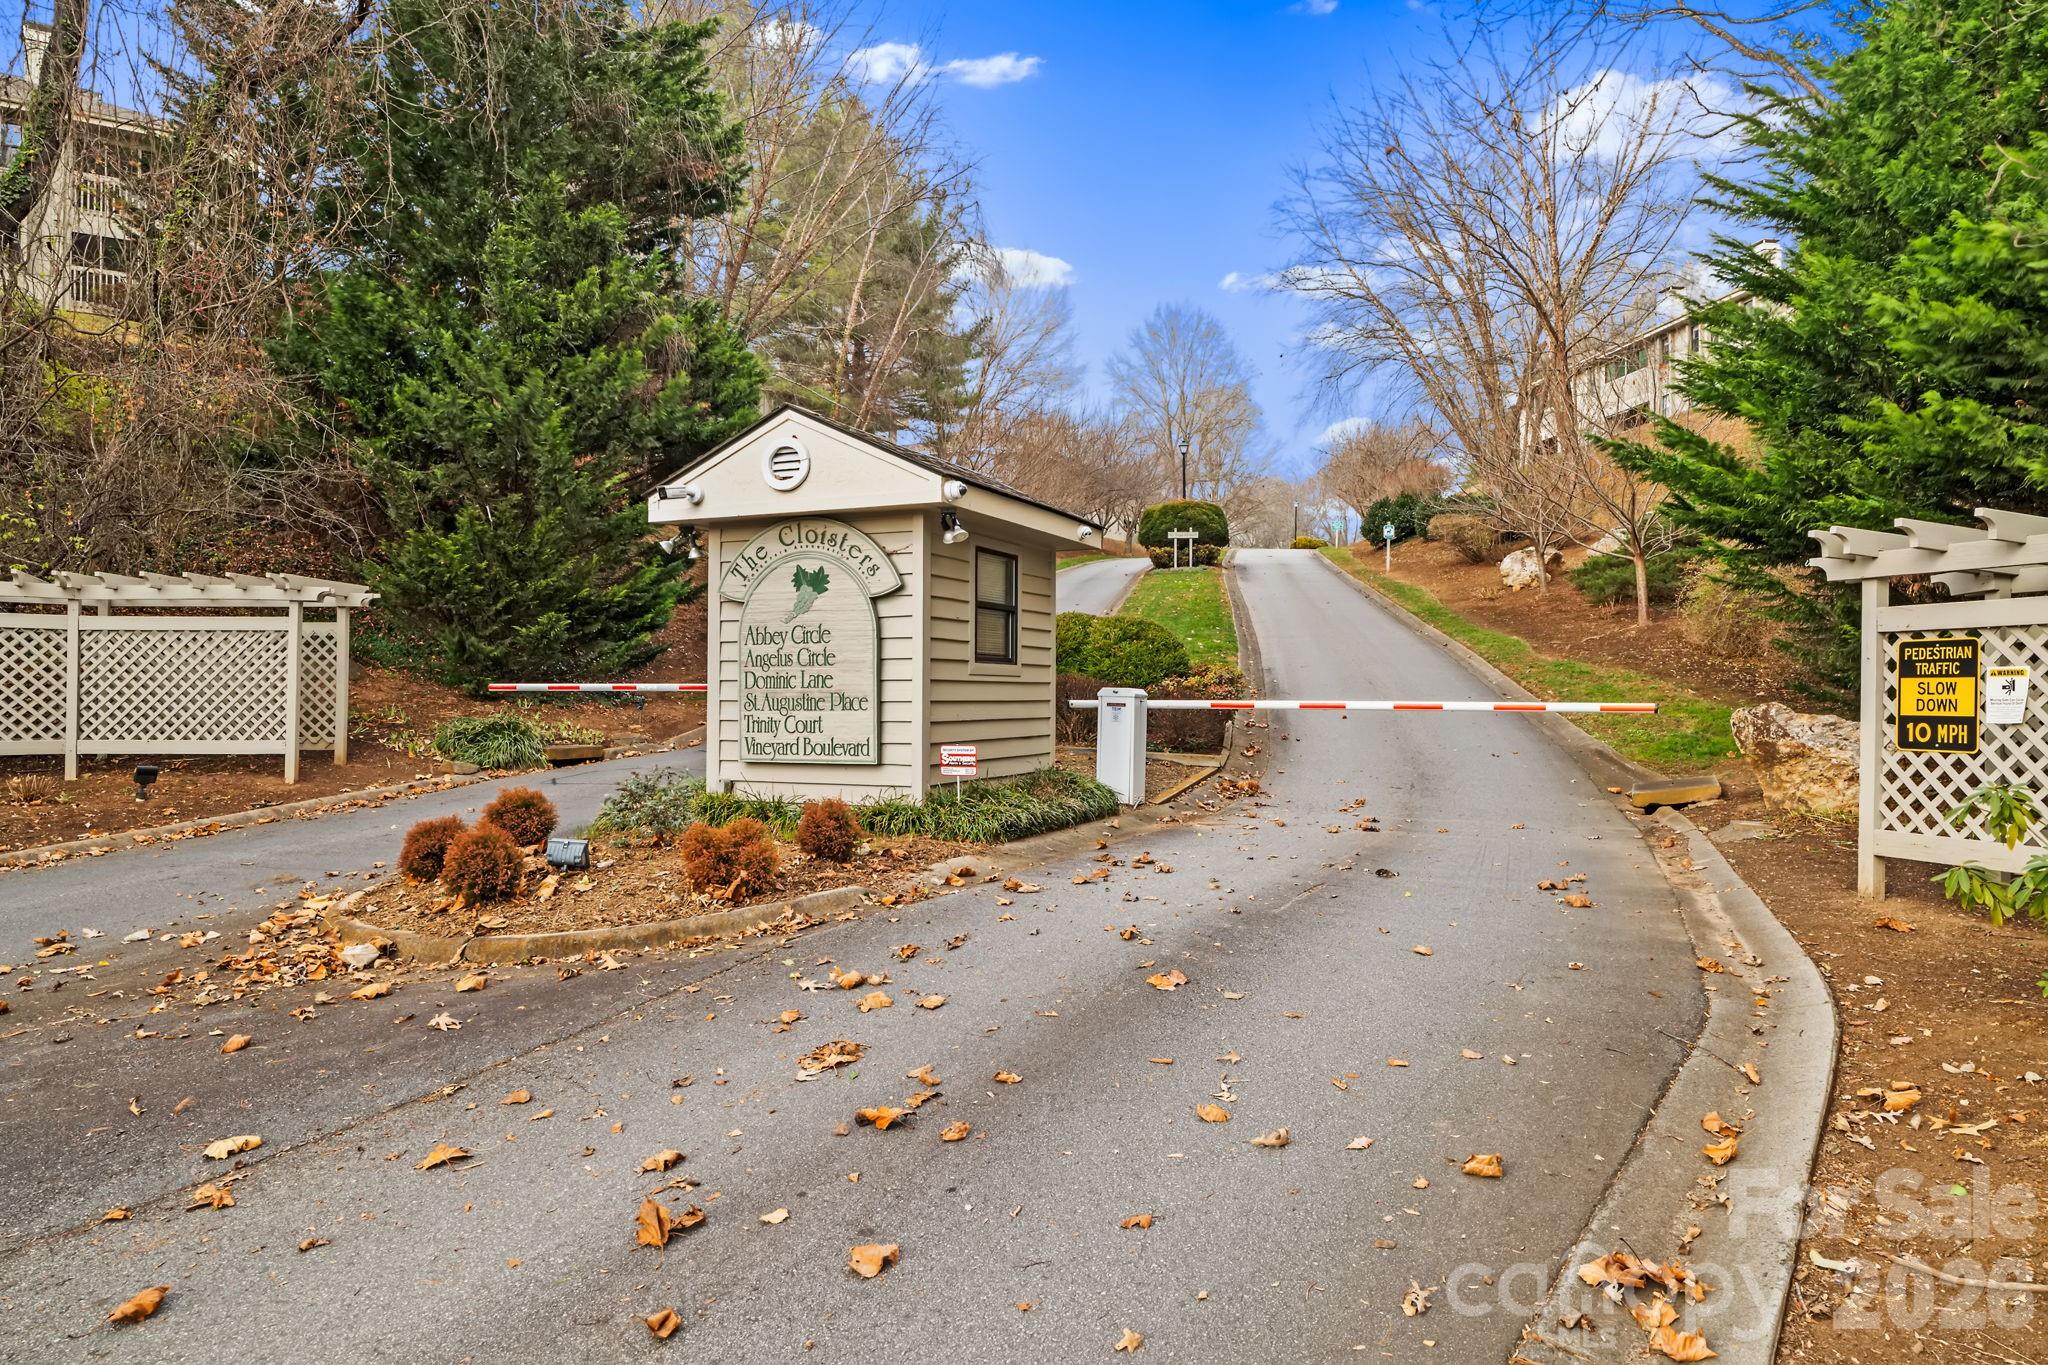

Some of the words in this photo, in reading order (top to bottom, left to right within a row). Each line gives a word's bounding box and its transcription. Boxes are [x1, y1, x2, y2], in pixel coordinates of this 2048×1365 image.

[730, 546, 768, 582] The
[778, 523, 880, 577] Cloisters
[744, 625, 788, 650] Abbey
[791, 623, 831, 644] Circle
[744, 648, 793, 672] Angelus
[797, 646, 836, 667] Circle
[1904, 646, 1972, 661] PEDESTRIAN
[1915, 662, 1960, 675] TRAFFIC
[744, 671, 797, 689] Dominic
[800, 670, 834, 689] Lane
[1917, 682, 1957, 695] SLOW
[829, 692, 868, 711] Place
[1916, 699, 1958, 712] DOWN
[744, 714, 781, 738] Trinity
[784, 714, 823, 733] Court
[1906, 722, 1931, 742] 10
[1937, 724, 1968, 744] MPH
[744, 737, 799, 760] Vineyard
[803, 736, 870, 756] Boulevard
